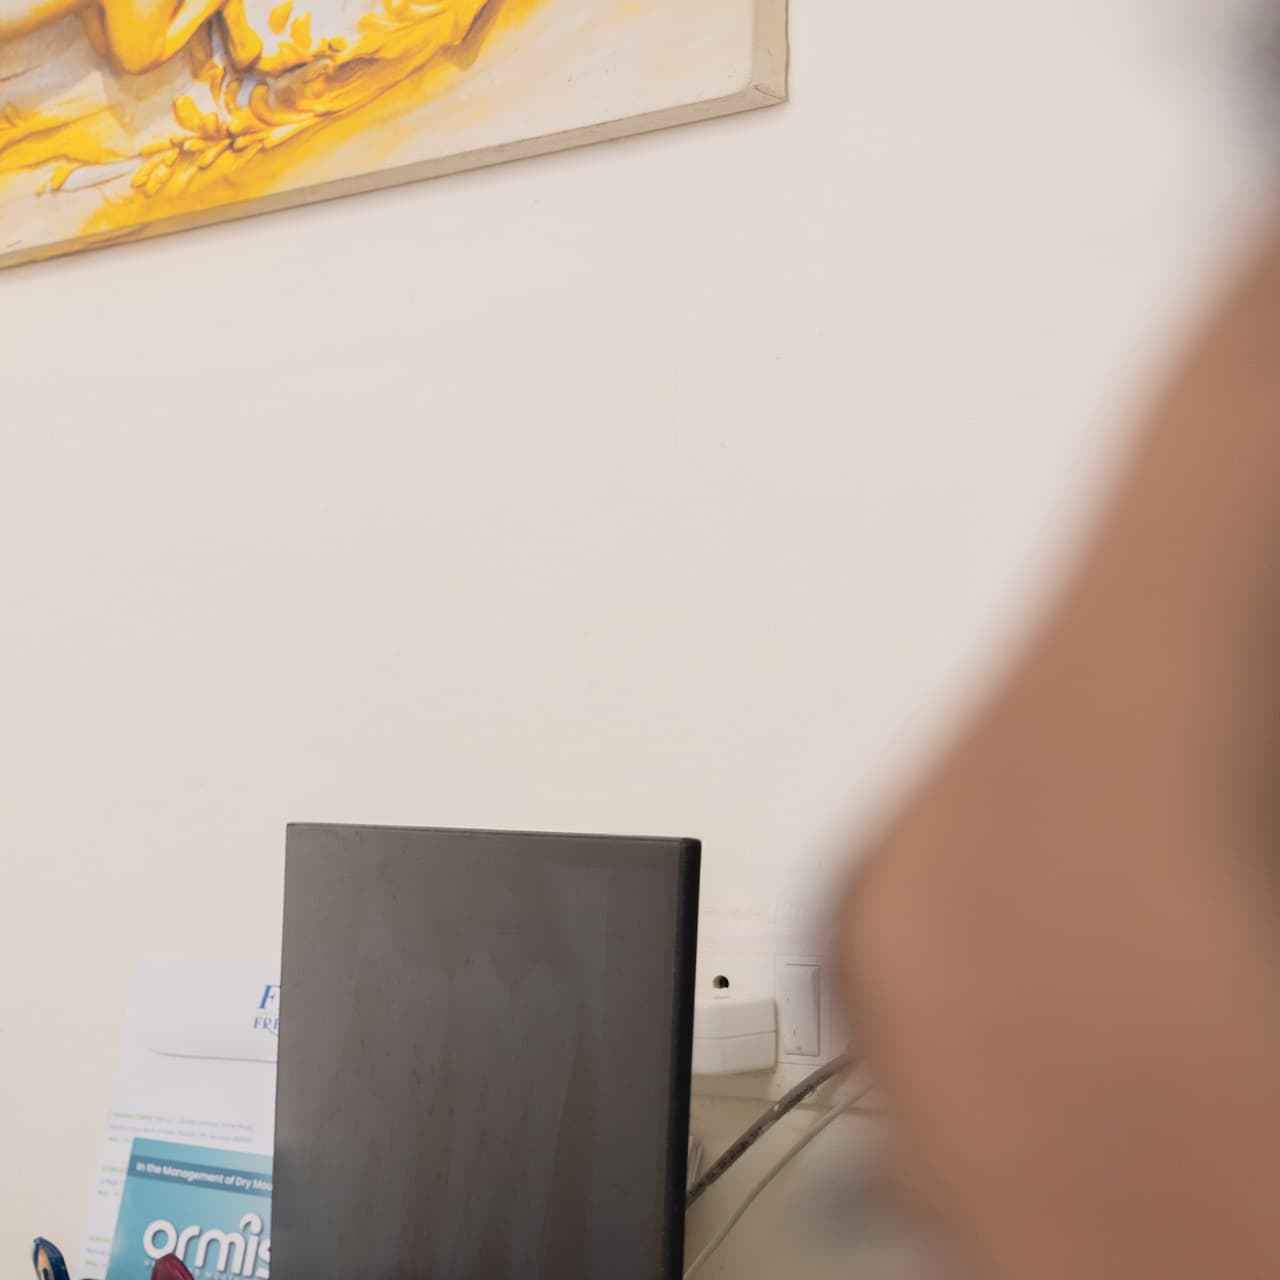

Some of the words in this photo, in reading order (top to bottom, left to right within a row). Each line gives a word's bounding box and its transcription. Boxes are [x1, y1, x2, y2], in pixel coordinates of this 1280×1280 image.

[136, 1161, 147, 1172] In
[147, 1163, 162, 1175] the
[163, 1165, 224, 1184] Management
[224, 1174, 235, 1185] of
[236, 1176, 252, 1190] Dry
